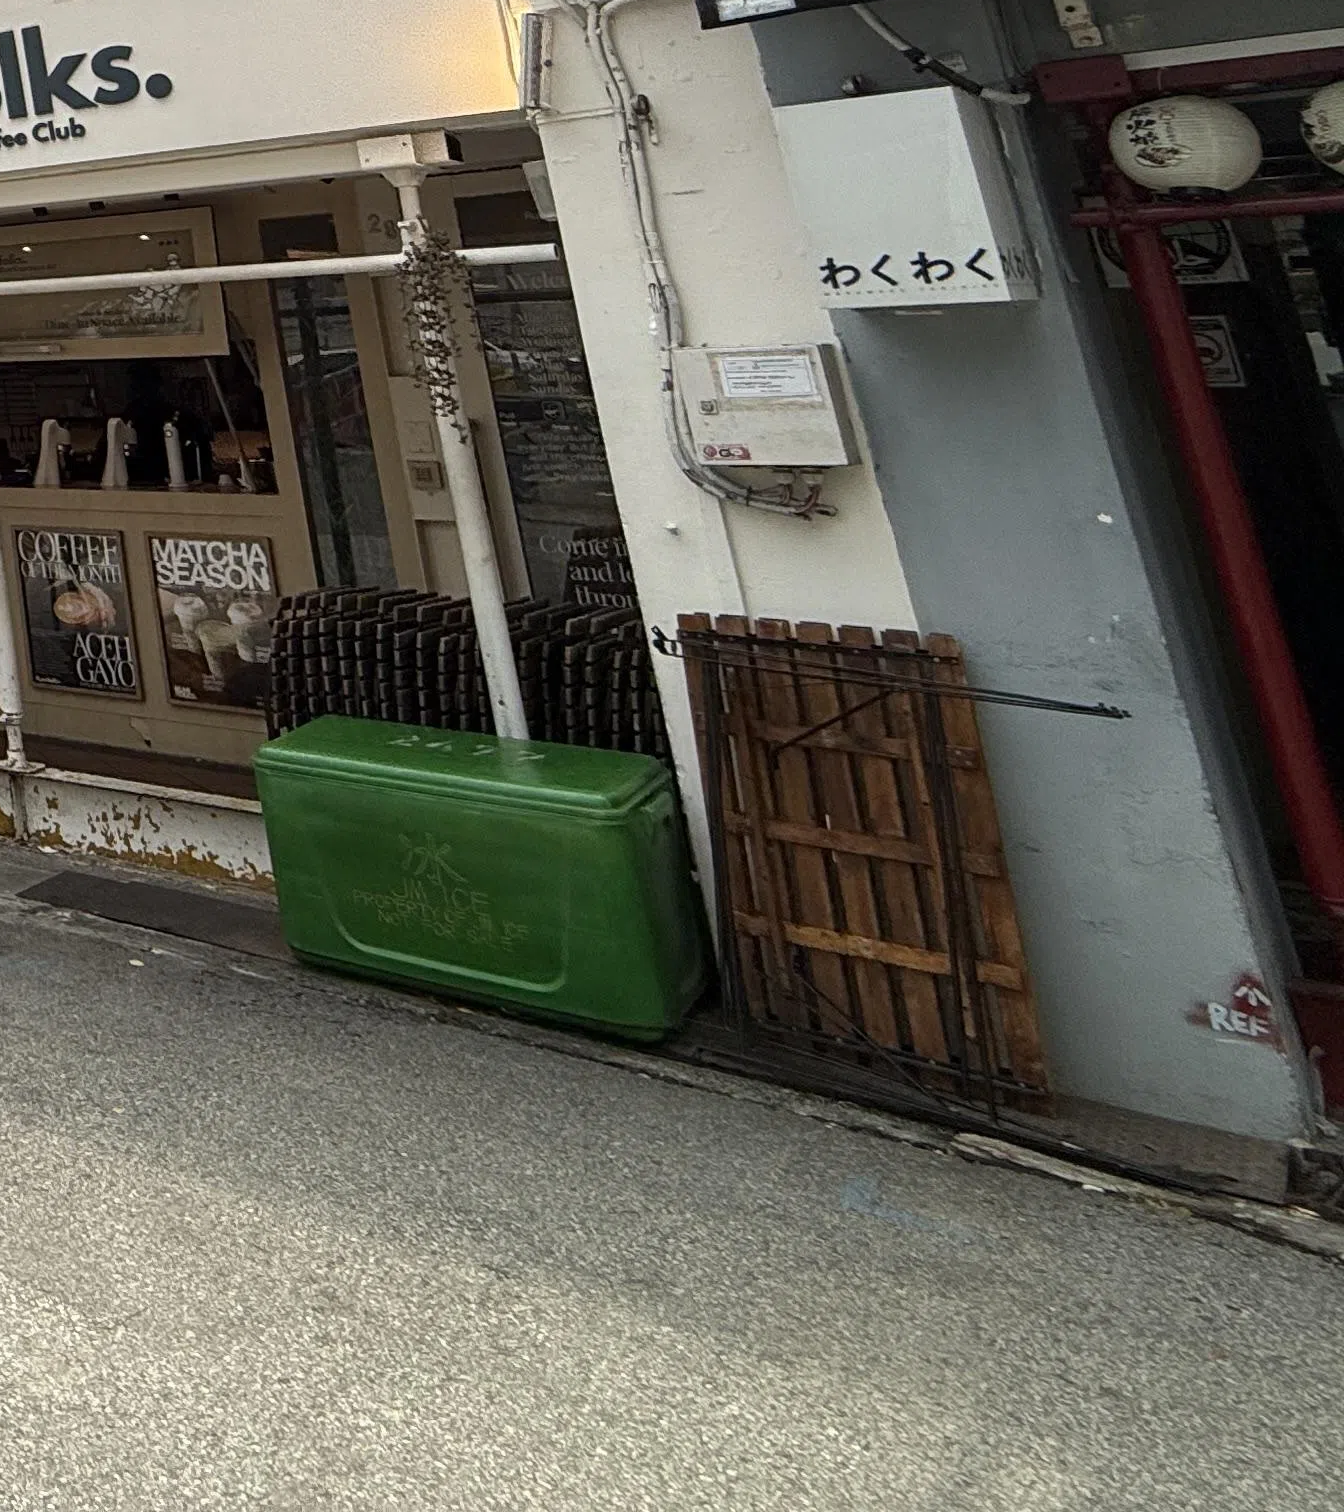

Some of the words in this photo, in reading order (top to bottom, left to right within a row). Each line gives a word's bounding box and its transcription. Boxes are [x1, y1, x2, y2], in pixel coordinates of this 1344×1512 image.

[32, 117, 87, 142] Club
[819, 247, 996, 289] わくわく
[17, 530, 117, 565] COFFEE
[151, 538, 268, 569] MATCHA
[539, 534, 609, 559] Come
[156, 560, 272, 592] SEASON
[568, 561, 614, 584] and
[73, 632, 133, 663] ACEH
[76, 656, 137, 687] GAYO
